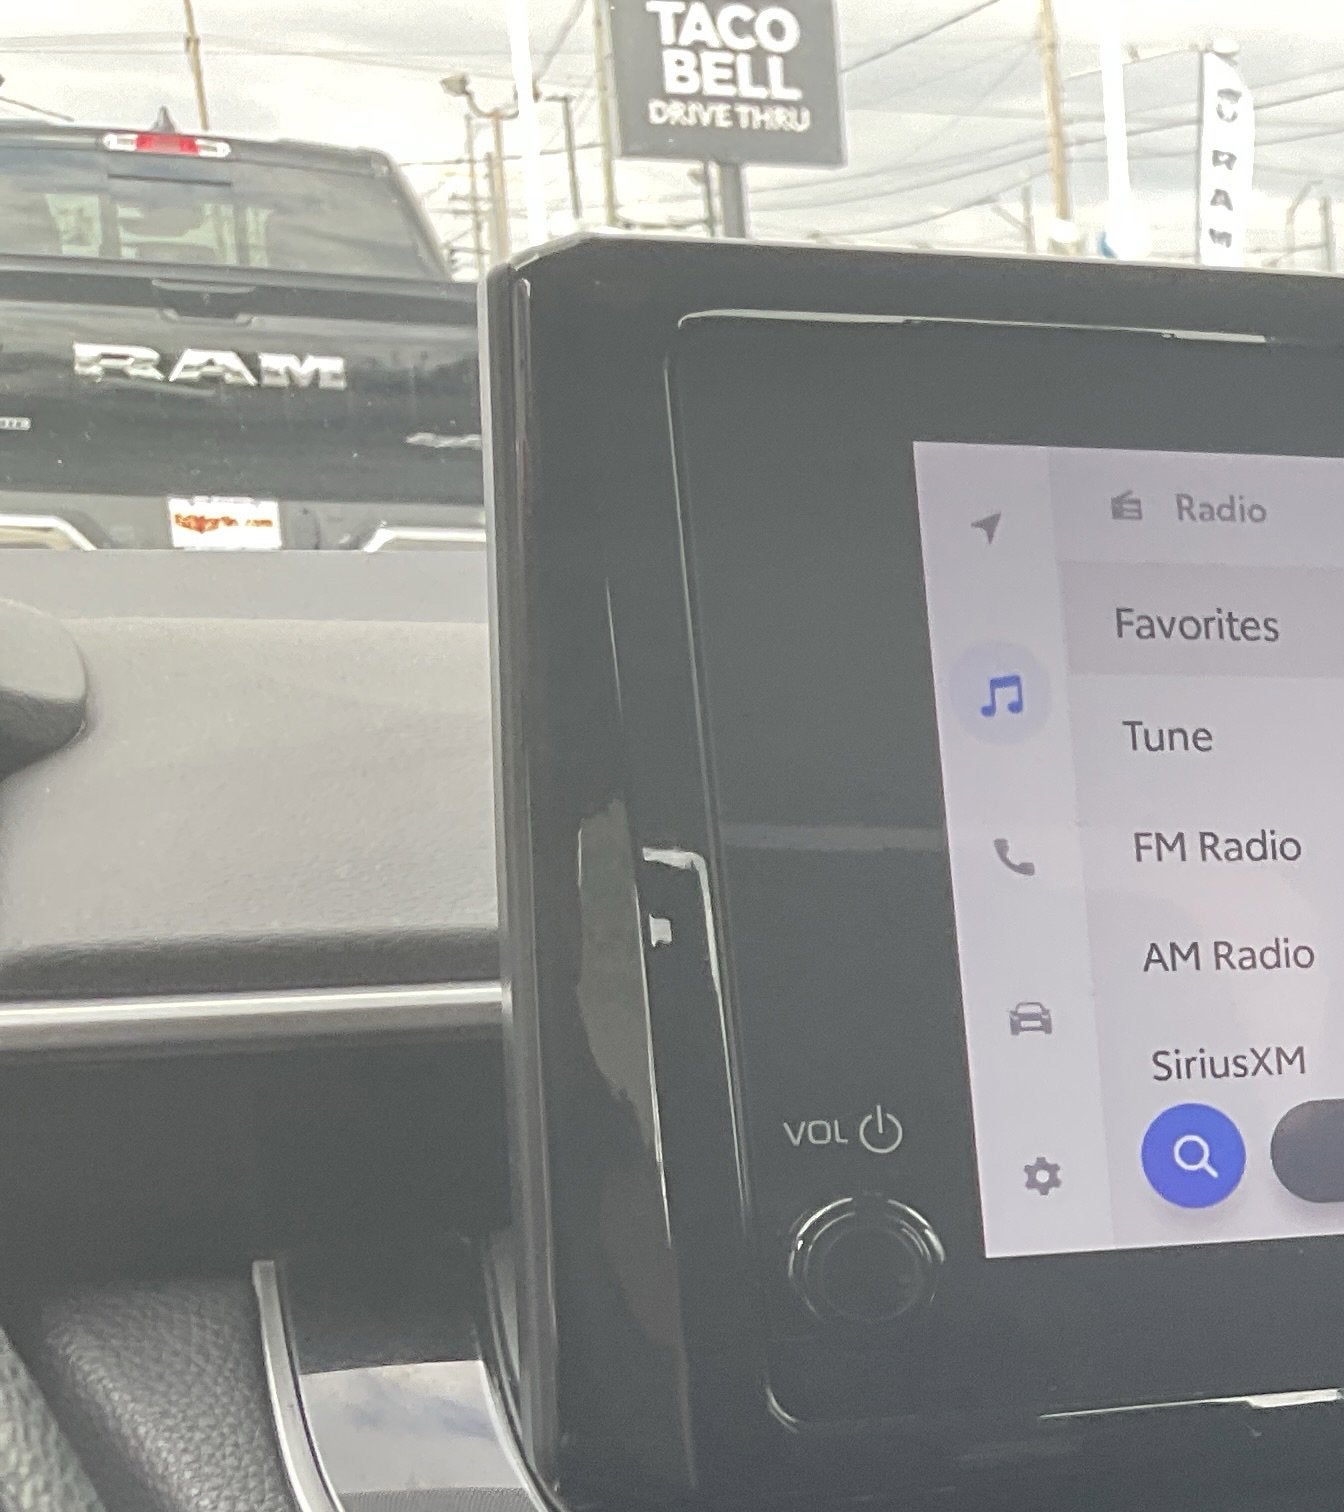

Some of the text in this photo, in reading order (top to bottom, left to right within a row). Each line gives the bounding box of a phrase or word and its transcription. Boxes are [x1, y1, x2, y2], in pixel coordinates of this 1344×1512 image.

[645, 0, 800, 52] TACO
[662, 49, 802, 100] BELL
[649, 99, 811, 132] DRIVE THRU
[73, 342, 347, 389] RAM
[1176, 492, 1268, 524] Radio
[1115, 607, 1280, 643] Favorites
[1123, 719, 1213, 752] Tune
[1134, 829, 1302, 863] FM Radio
[1142, 936, 1315, 972] AM Radio
[1151, 1044, 1307, 1082] SiriusXM
[783, 1119, 849, 1146] VOL
